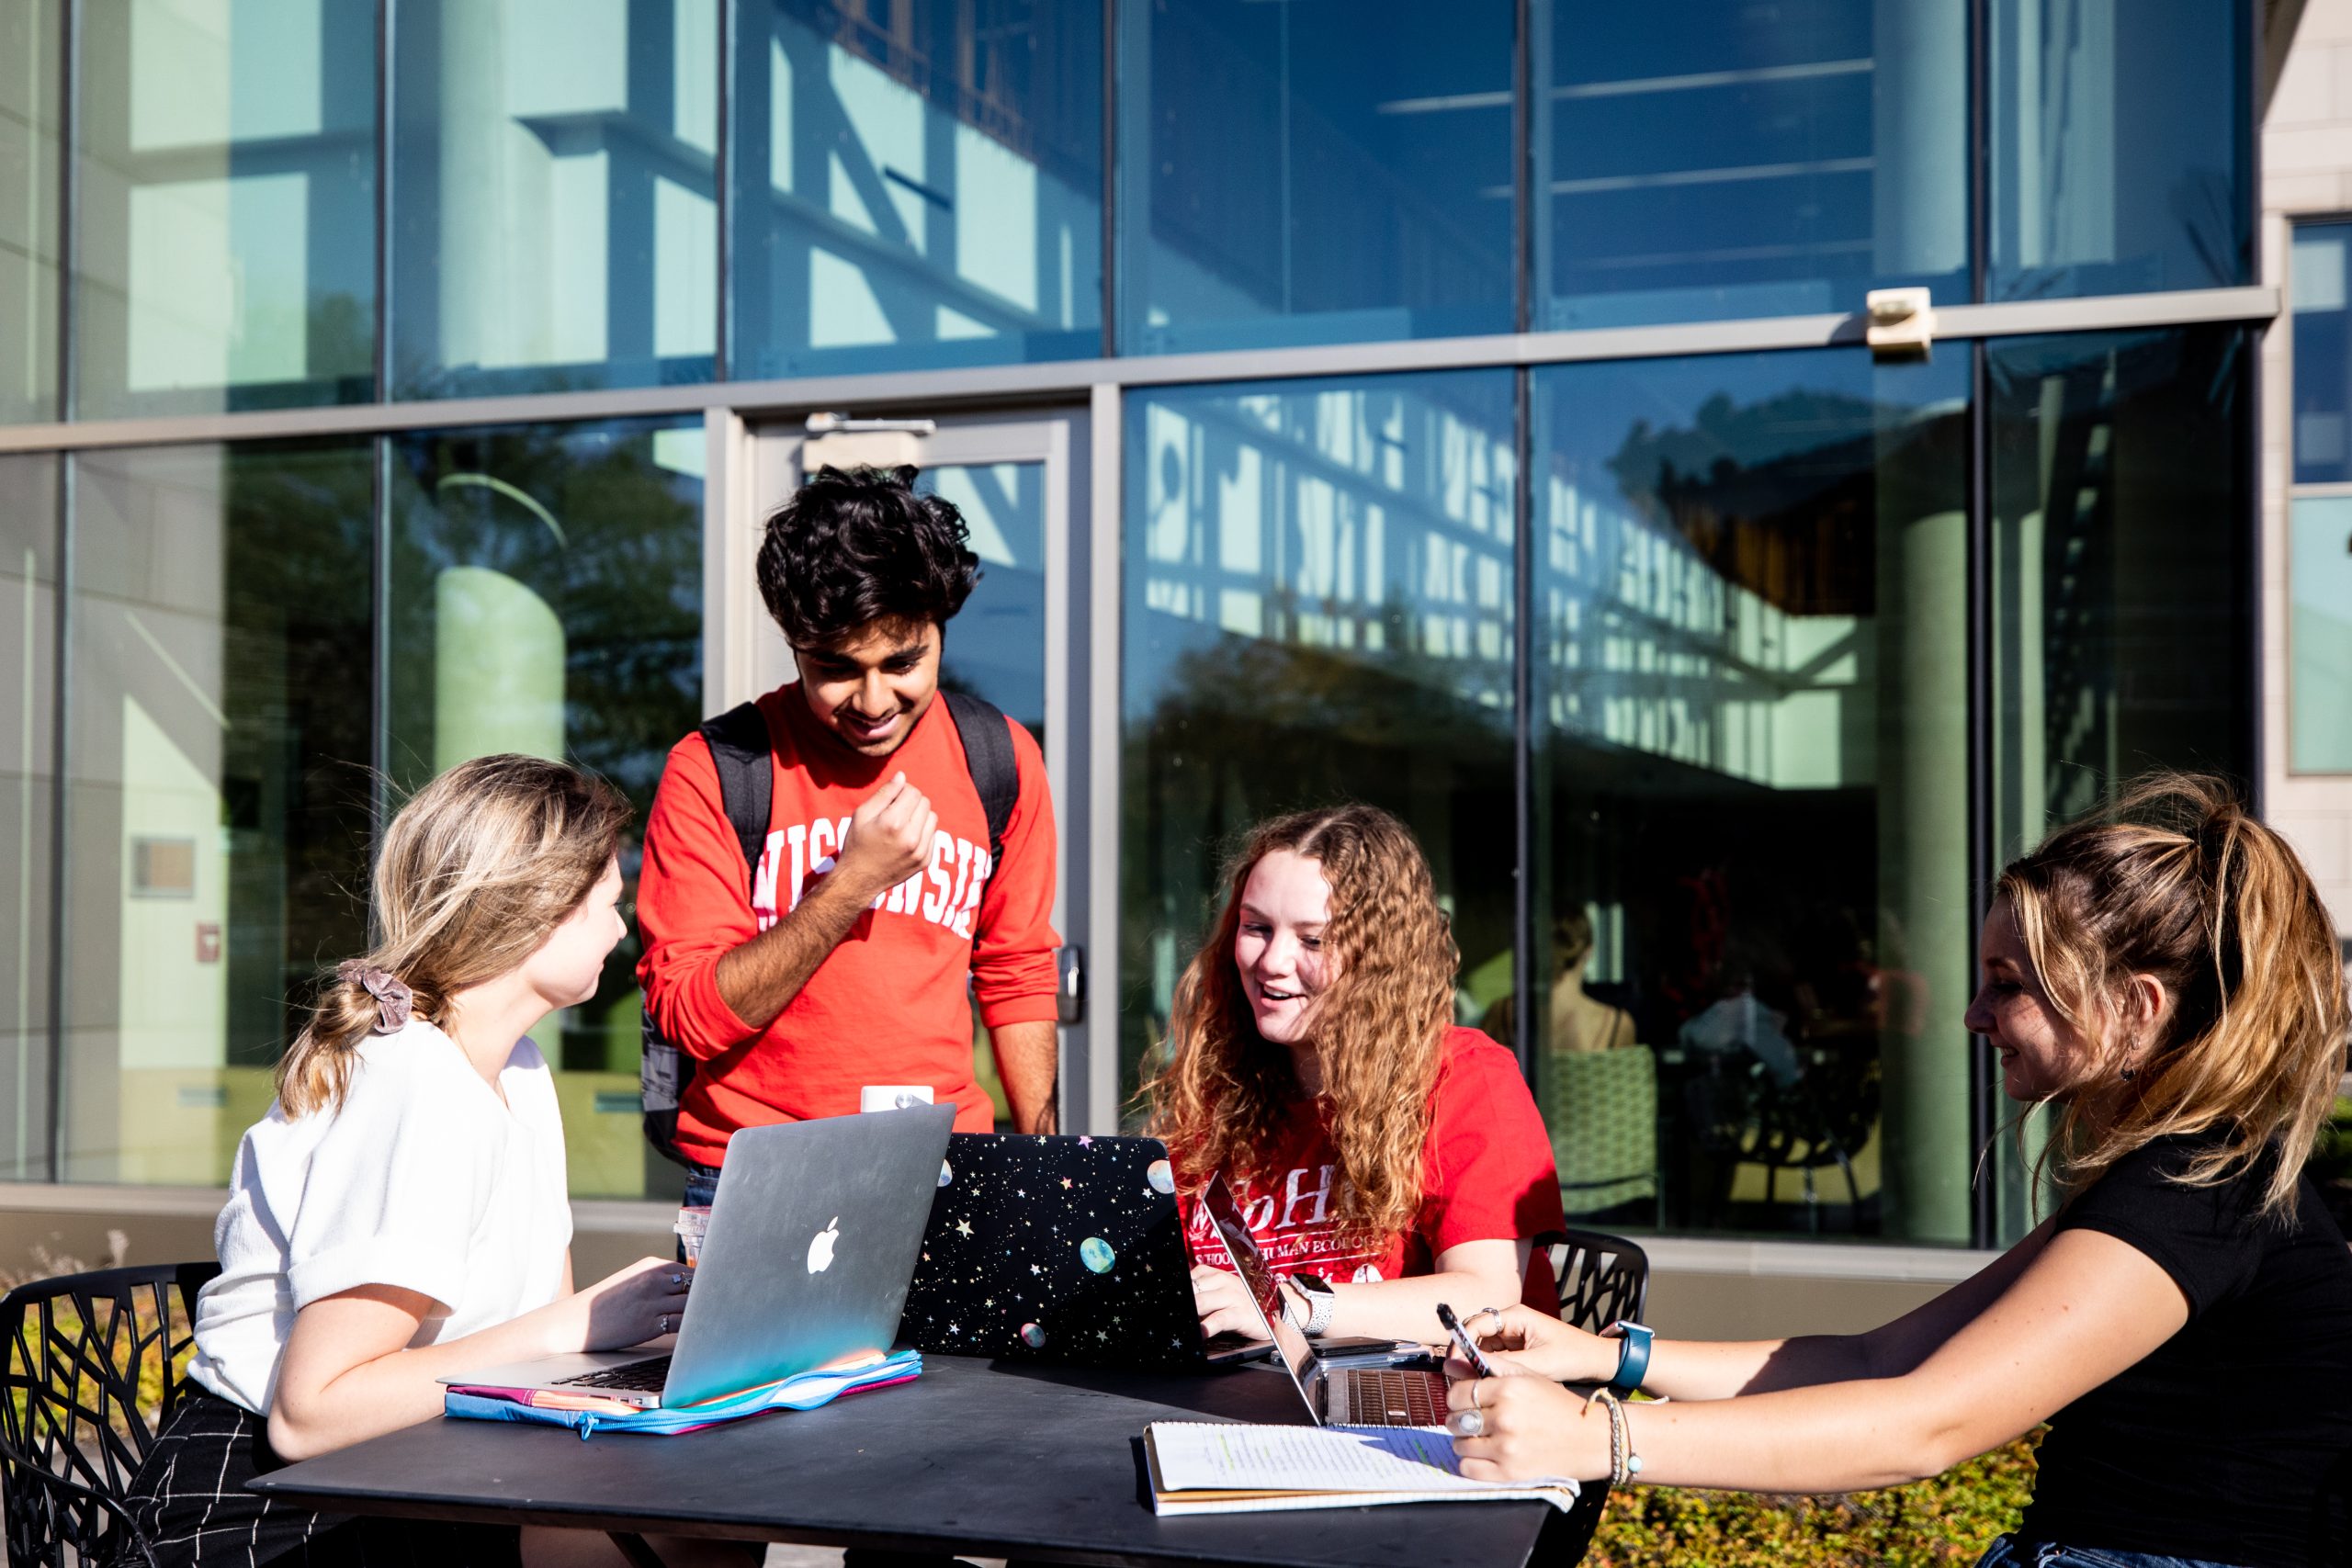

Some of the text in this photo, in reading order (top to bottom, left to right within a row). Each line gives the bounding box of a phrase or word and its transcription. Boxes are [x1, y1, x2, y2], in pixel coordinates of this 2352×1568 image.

[752, 817, 992, 940] WISSIN
[1195, 1251, 1234, 1266] SCHOO
[1312, 1235, 1376, 1254] ECOLOG
